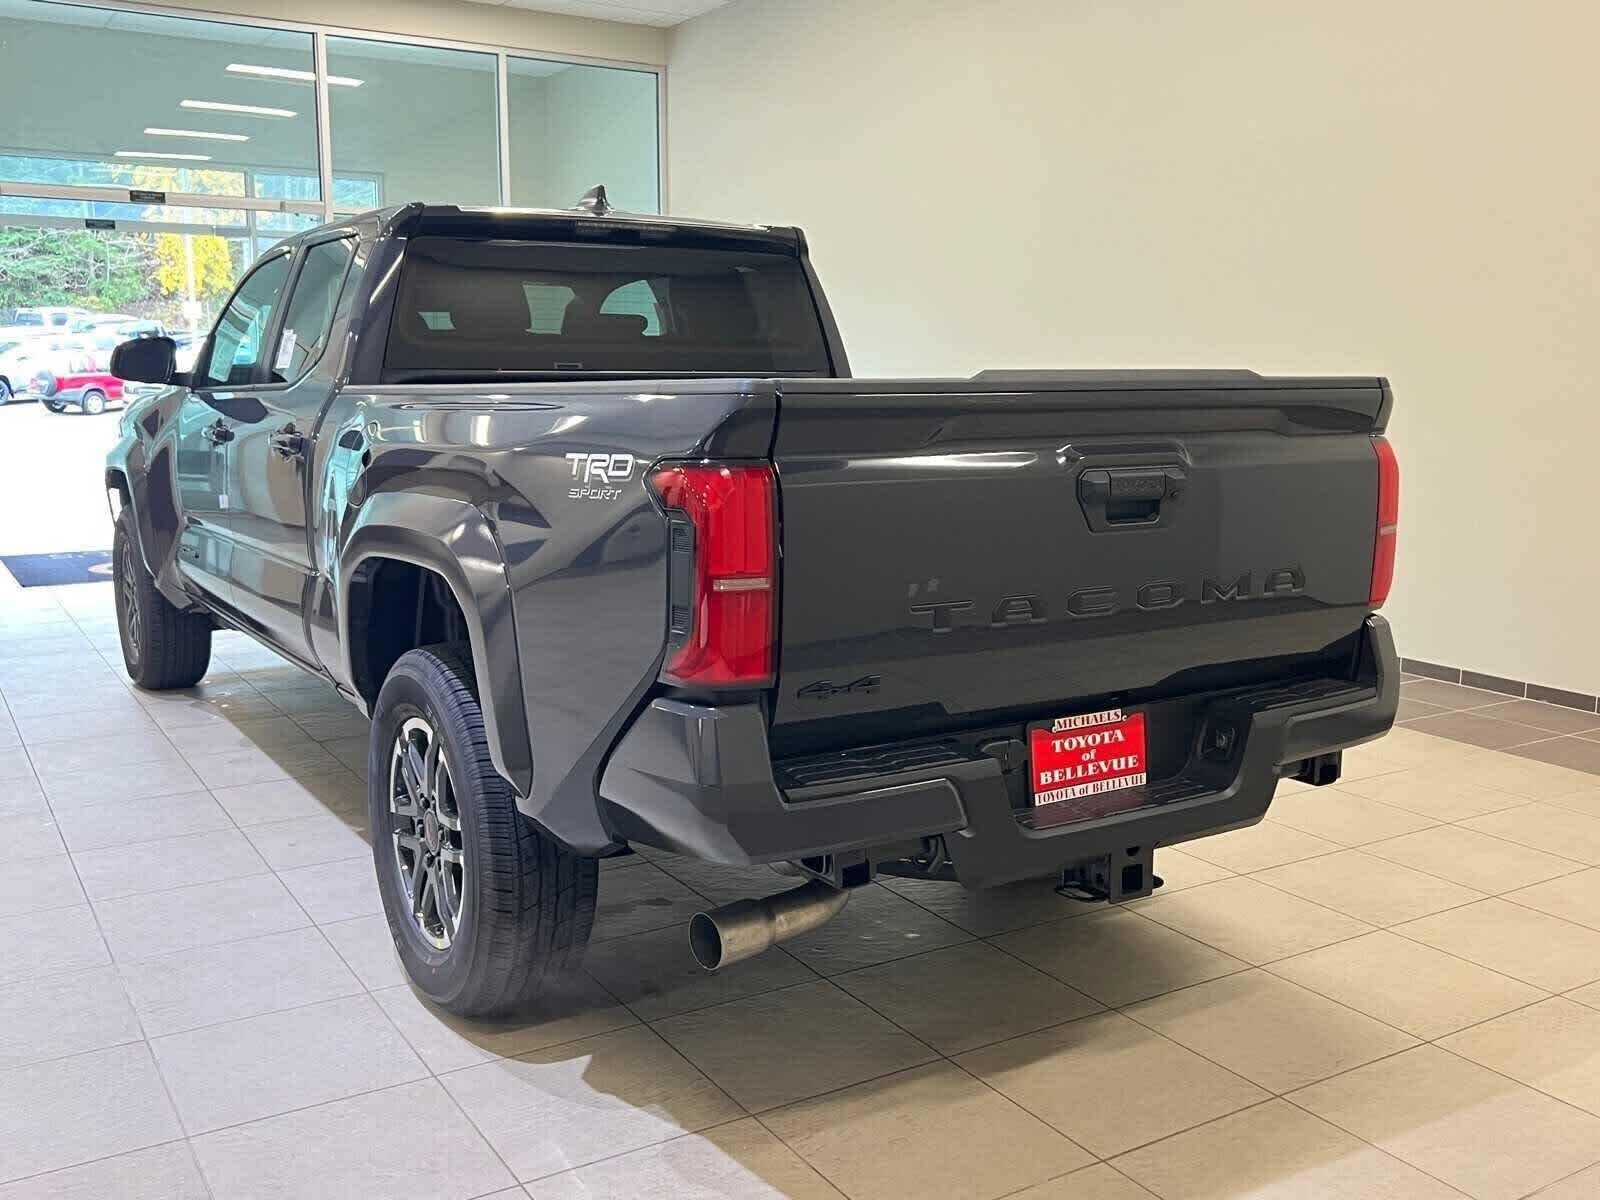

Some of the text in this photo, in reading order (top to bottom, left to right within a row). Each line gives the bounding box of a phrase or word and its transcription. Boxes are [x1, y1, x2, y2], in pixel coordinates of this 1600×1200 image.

[565, 453, 634, 484] TRD
[568, 488, 622, 500] SPORT
[908, 566, 1306, 633] TACOMA
[1056, 710, 1120, 729] MICHAELS
[1052, 729, 1125, 753] TOYOTA
[1081, 749, 1097, 762] of
[1040, 755, 1139, 785] BELLEVUE
[1037, 773, 1144, 804] TOYOTA of BELLEVUE
